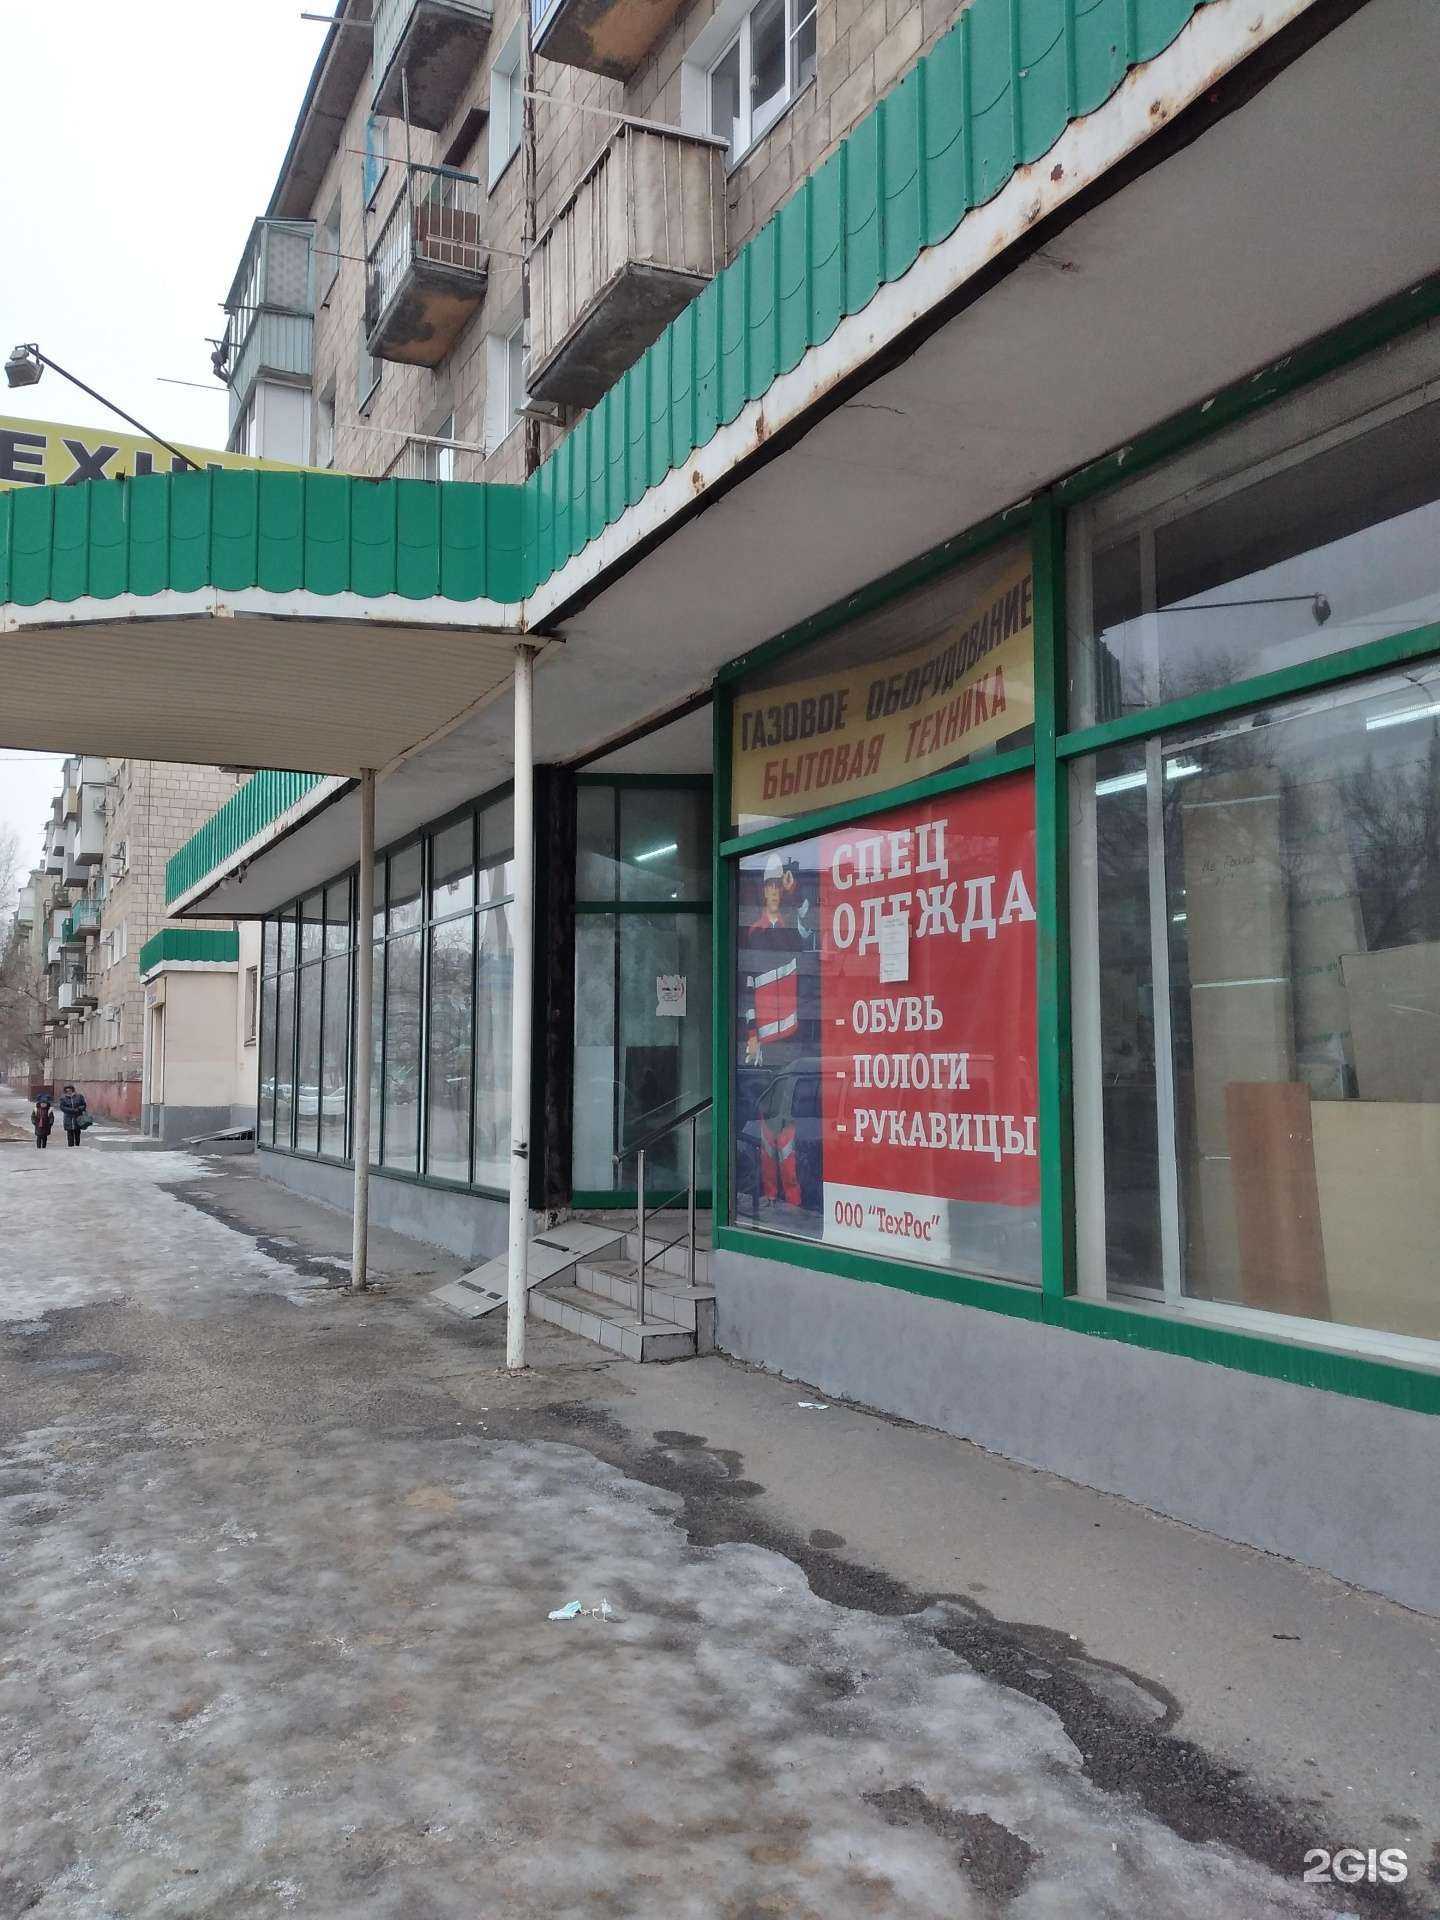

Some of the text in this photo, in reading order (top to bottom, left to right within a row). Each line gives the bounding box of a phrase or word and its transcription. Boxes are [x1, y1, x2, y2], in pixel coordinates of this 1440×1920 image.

[741, 574, 1032, 752] ГАЗОВОЕ ОБОРУДОВАНИЕ
[762, 664, 1007, 801] БЫТОВАЯ ТЕХНИКА
[832, 819, 949, 890] СПЕЦ
[852, 995, 944, 1034] ОБУВЬ
[853, 1052, 970, 1090] ПОЛОГИ
[853, 1108, 1037, 1162] РУКАВИЦЫ
[834, 1200, 864, 1229] ООО
